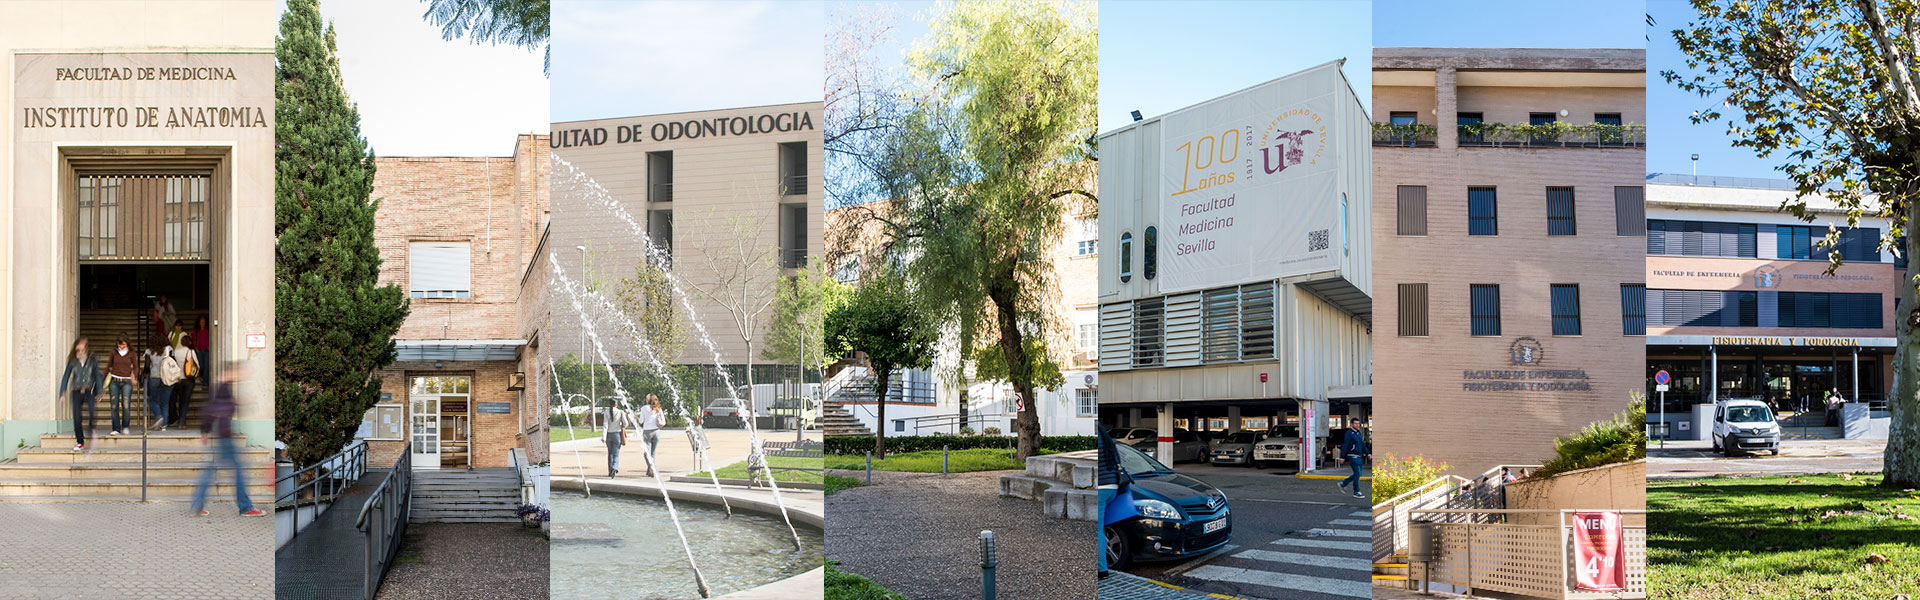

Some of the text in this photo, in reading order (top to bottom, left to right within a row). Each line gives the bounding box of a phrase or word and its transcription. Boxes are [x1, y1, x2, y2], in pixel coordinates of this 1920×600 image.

[56, 68, 237, 81] FACULTAD DE MEDICINA
[24, 107, 268, 129] INSTITUTO DE ANATOMIA
[550, 111, 814, 149] ULTAD DE ODONTOLOGIA
[1260, 108, 1327, 165] UNIVERSIDAD DE SEVILLA
[1171, 128, 1240, 197] 100
[1199, 171, 1236, 190] años
[1181, 193, 1236, 217] Facultad
[1178, 216, 1234, 237] Medicina
[1176, 239, 1216, 256] Sevilla
[1712, 336, 1859, 346] FISIOTERAPIA Y PODOLOGIA
[1463, 370, 1511, 379] FACULTAD
[1513, 370, 1525, 379] DE
[1463, 382, 1527, 392] FISIOTERAPIA
[1527, 382, 1534, 392] Y
